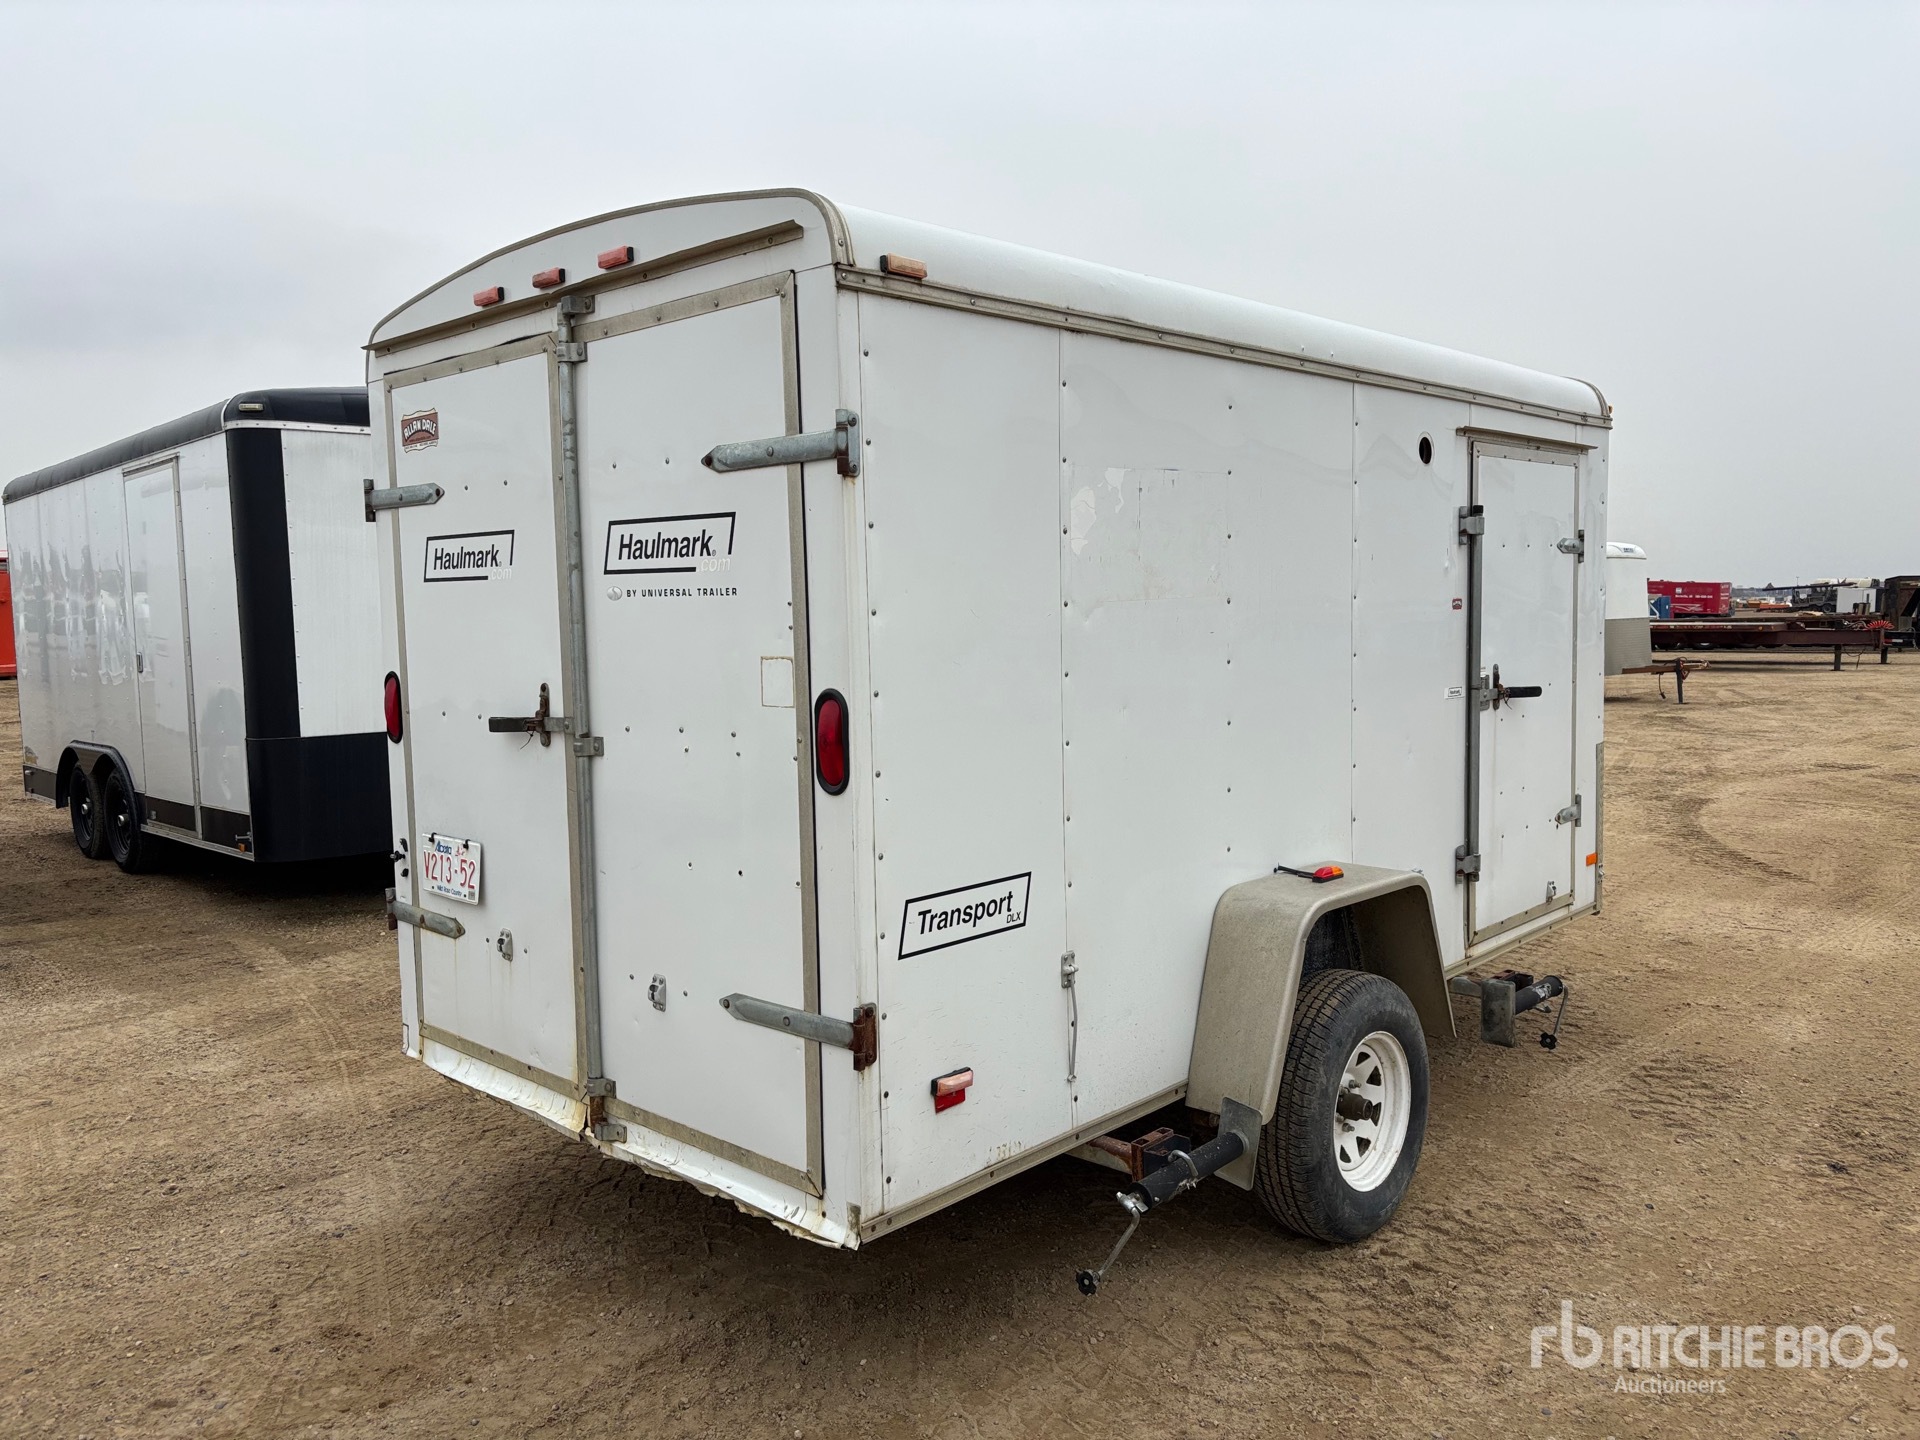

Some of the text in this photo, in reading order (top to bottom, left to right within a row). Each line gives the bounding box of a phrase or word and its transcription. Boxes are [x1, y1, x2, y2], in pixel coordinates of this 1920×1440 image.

[403, 418, 437, 440] ALLAN DALE
[618, 529, 713, 560] Haulmark
[433, 544, 499, 570] Haulmark
[626, 587, 737, 597] BY UNIVERSAL TRAILER
[918, 891, 1013, 935] Transport
[1006, 911, 1021, 923] DLX
